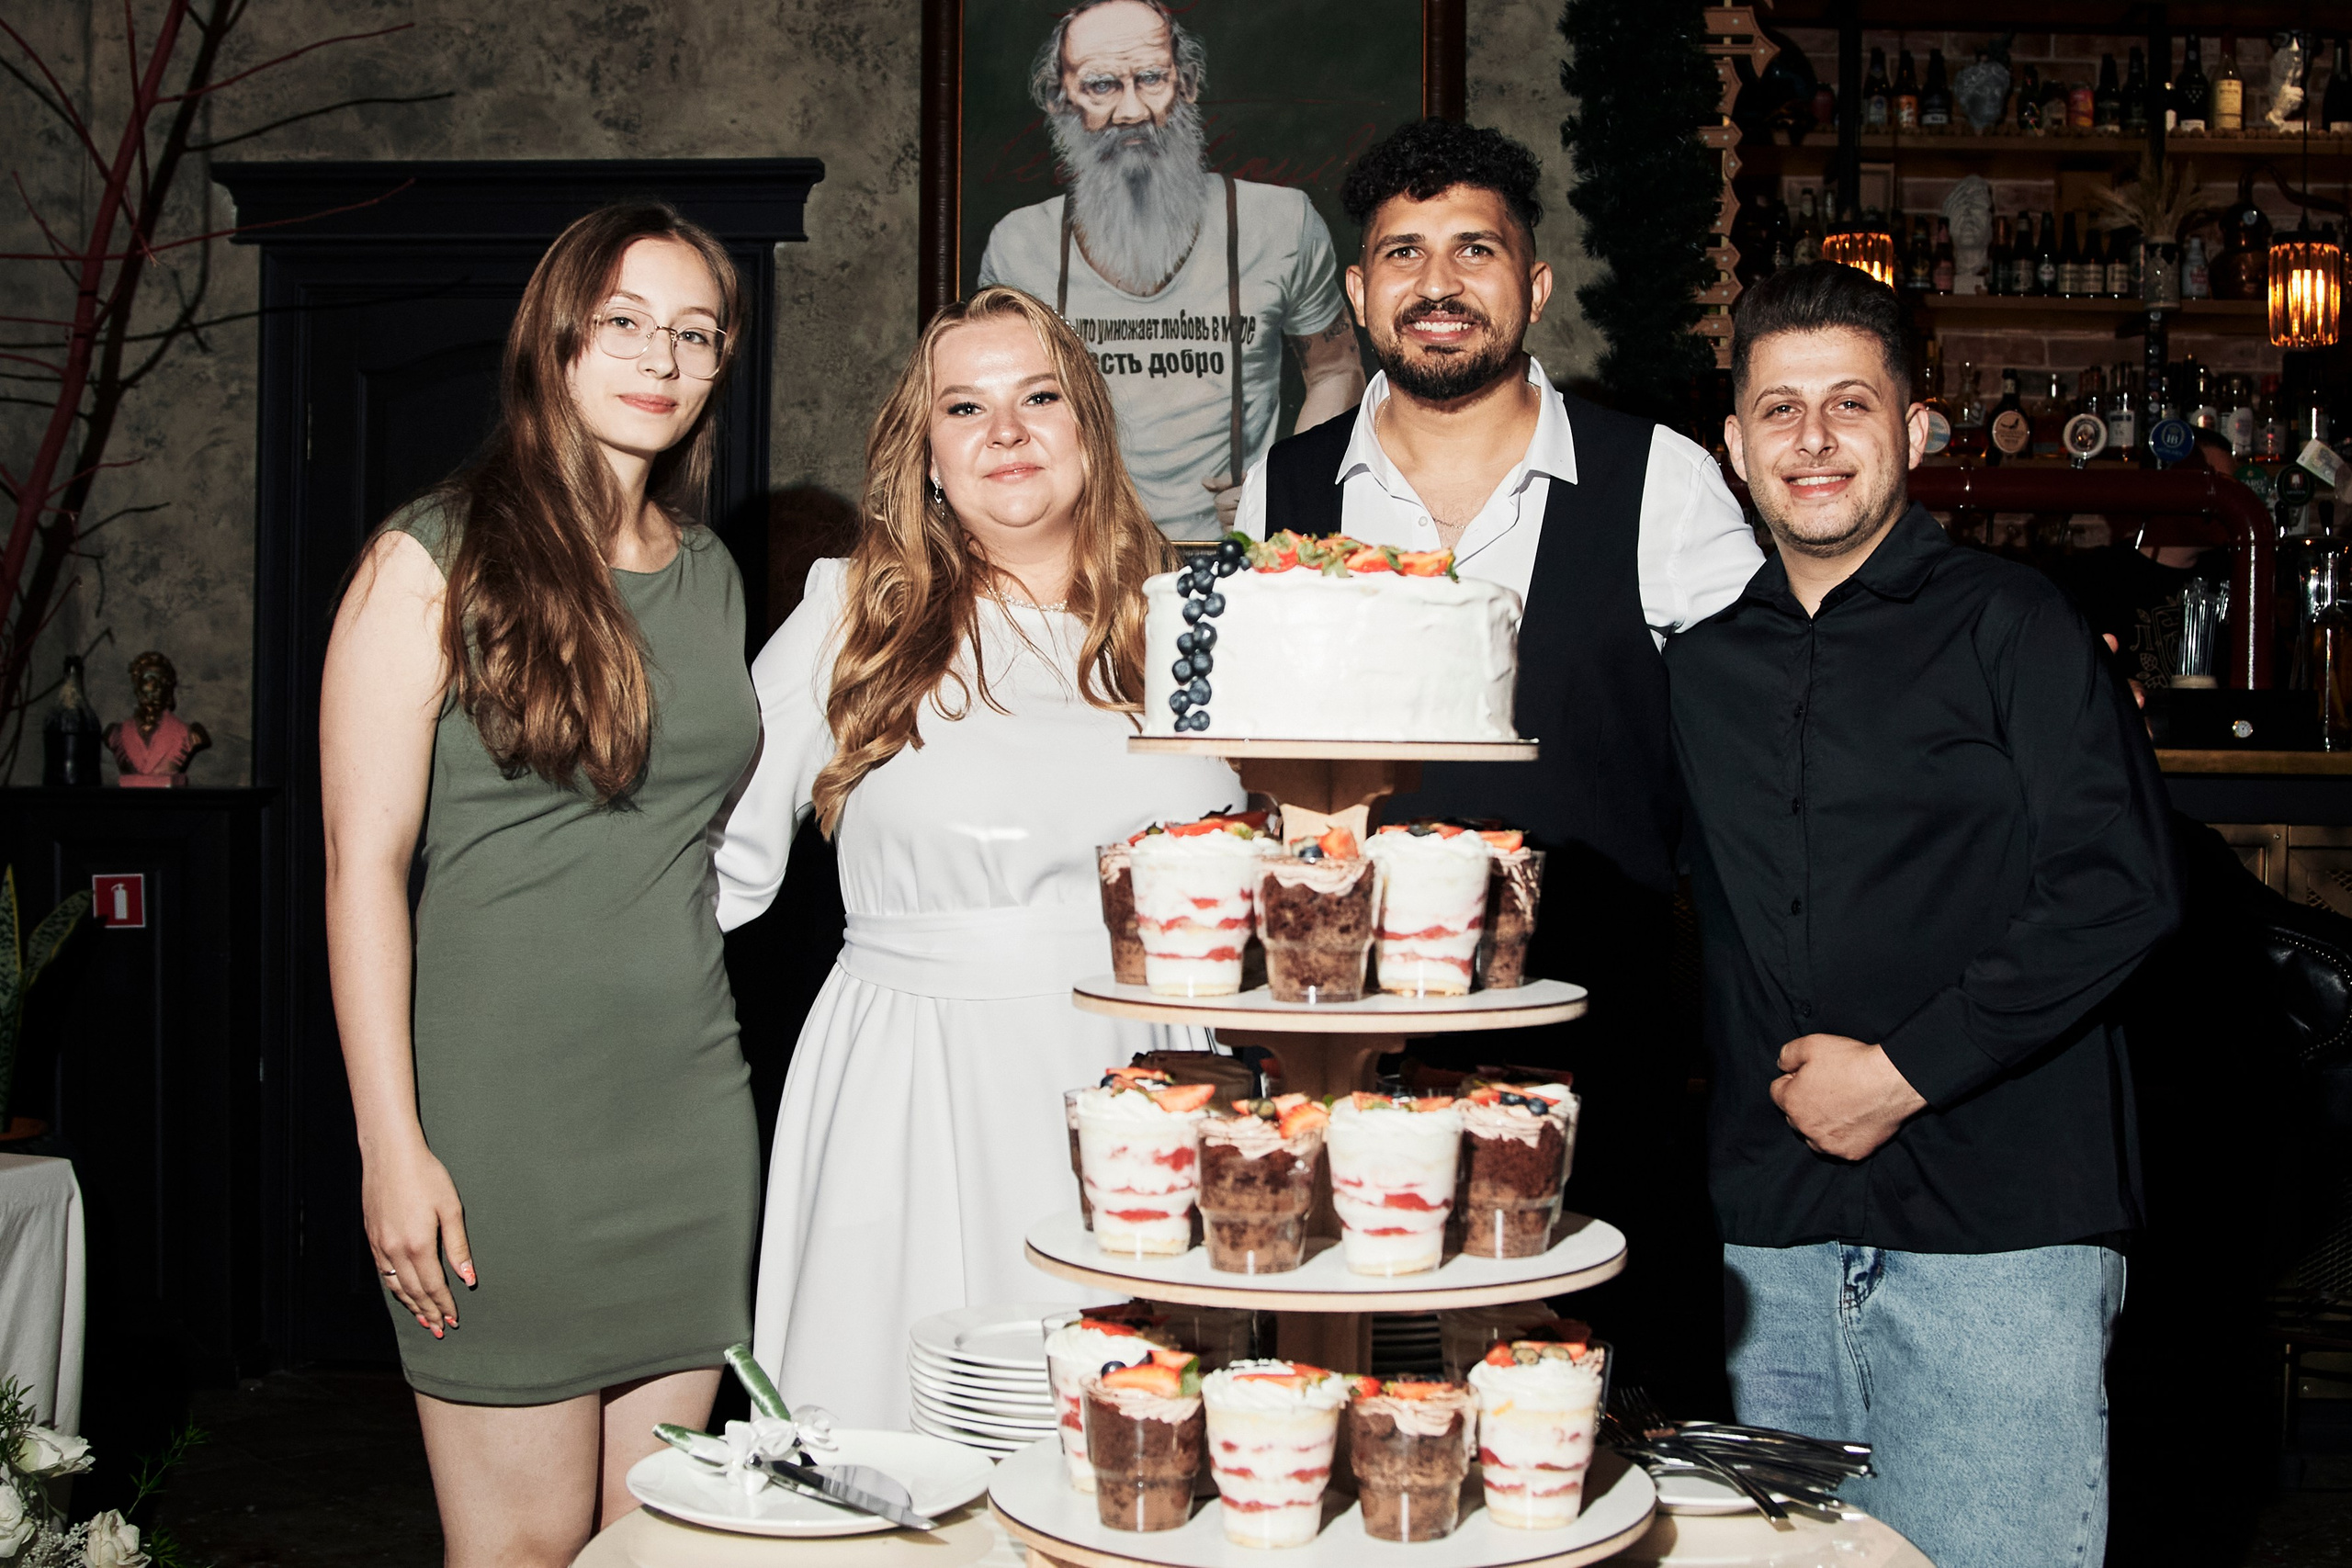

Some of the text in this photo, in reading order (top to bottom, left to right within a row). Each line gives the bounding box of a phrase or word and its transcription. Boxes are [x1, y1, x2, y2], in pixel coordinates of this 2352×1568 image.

[1097, 318, 1159, 344] умножает
[1160, 309, 1210, 341] любовь
[1212, 315, 1219, 341] в
[1221, 315, 1256, 344] мре
[1148, 349, 1225, 378] добро
